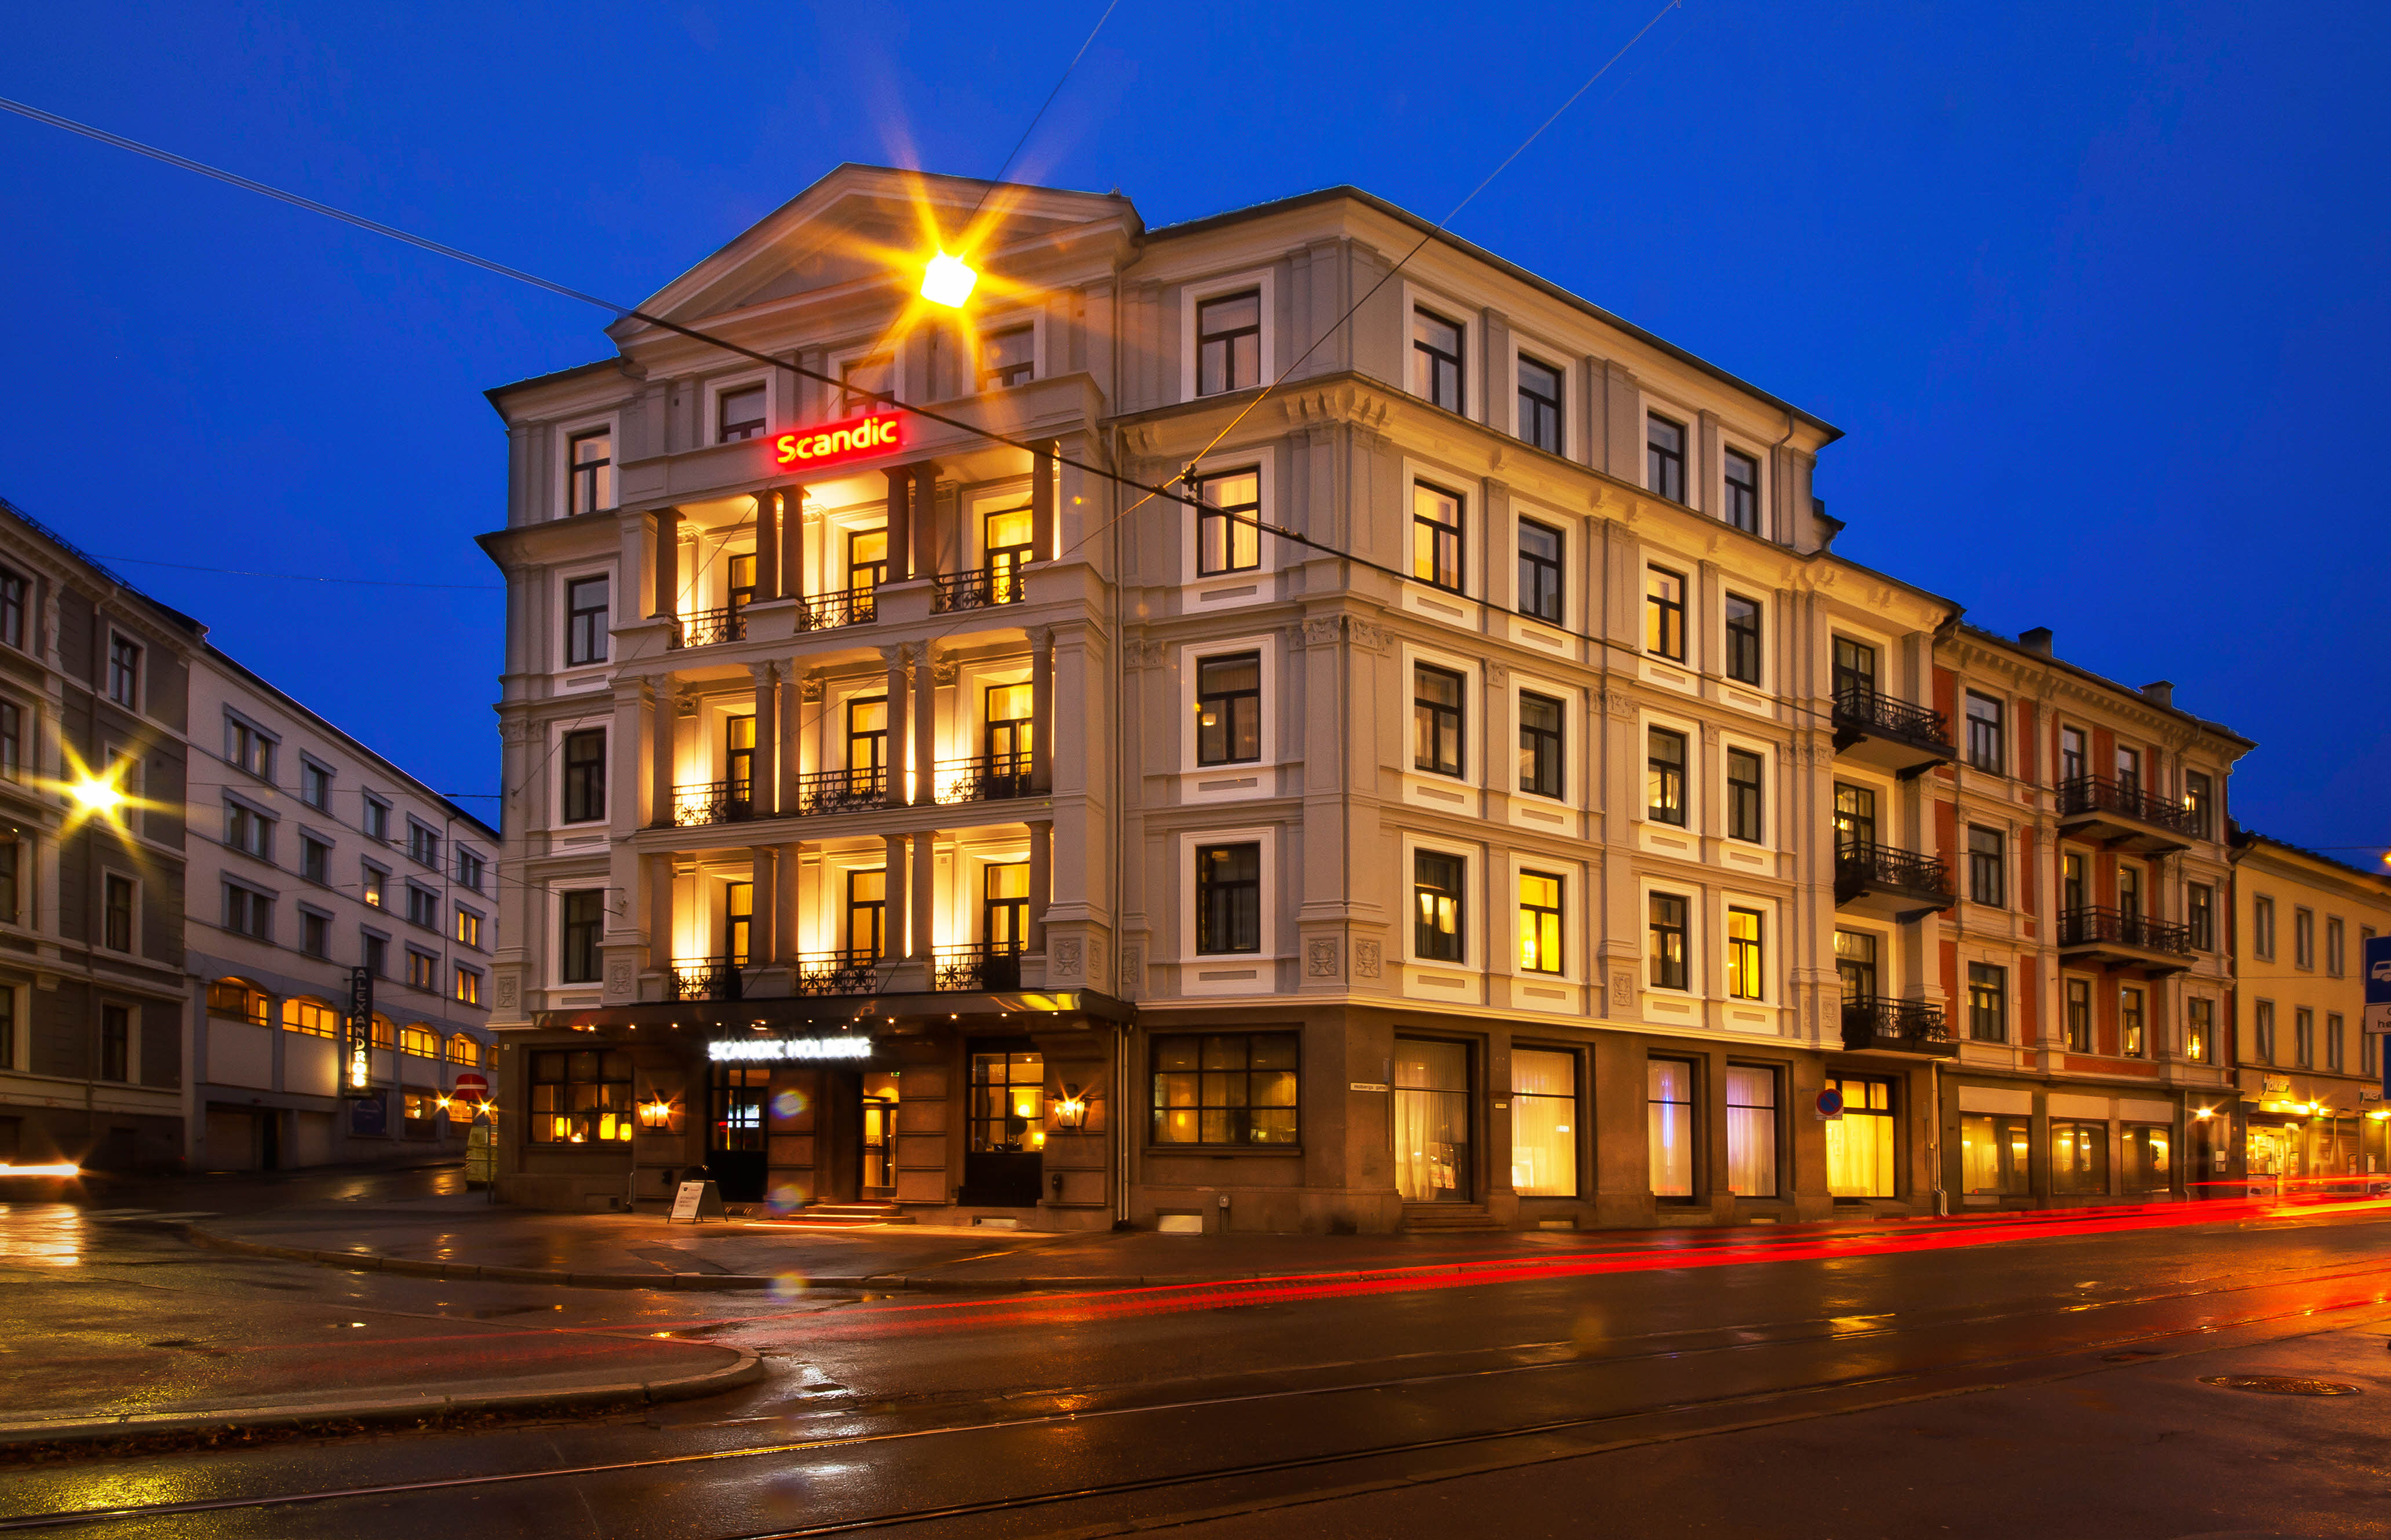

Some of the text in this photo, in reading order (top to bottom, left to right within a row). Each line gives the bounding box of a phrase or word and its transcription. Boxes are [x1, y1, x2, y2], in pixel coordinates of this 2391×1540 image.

[777, 418, 897, 464] Scandic
[353, 969, 367, 1087] ALEXANDROS
[709, 1038, 870, 1060] SCANDIC HOLBERG
